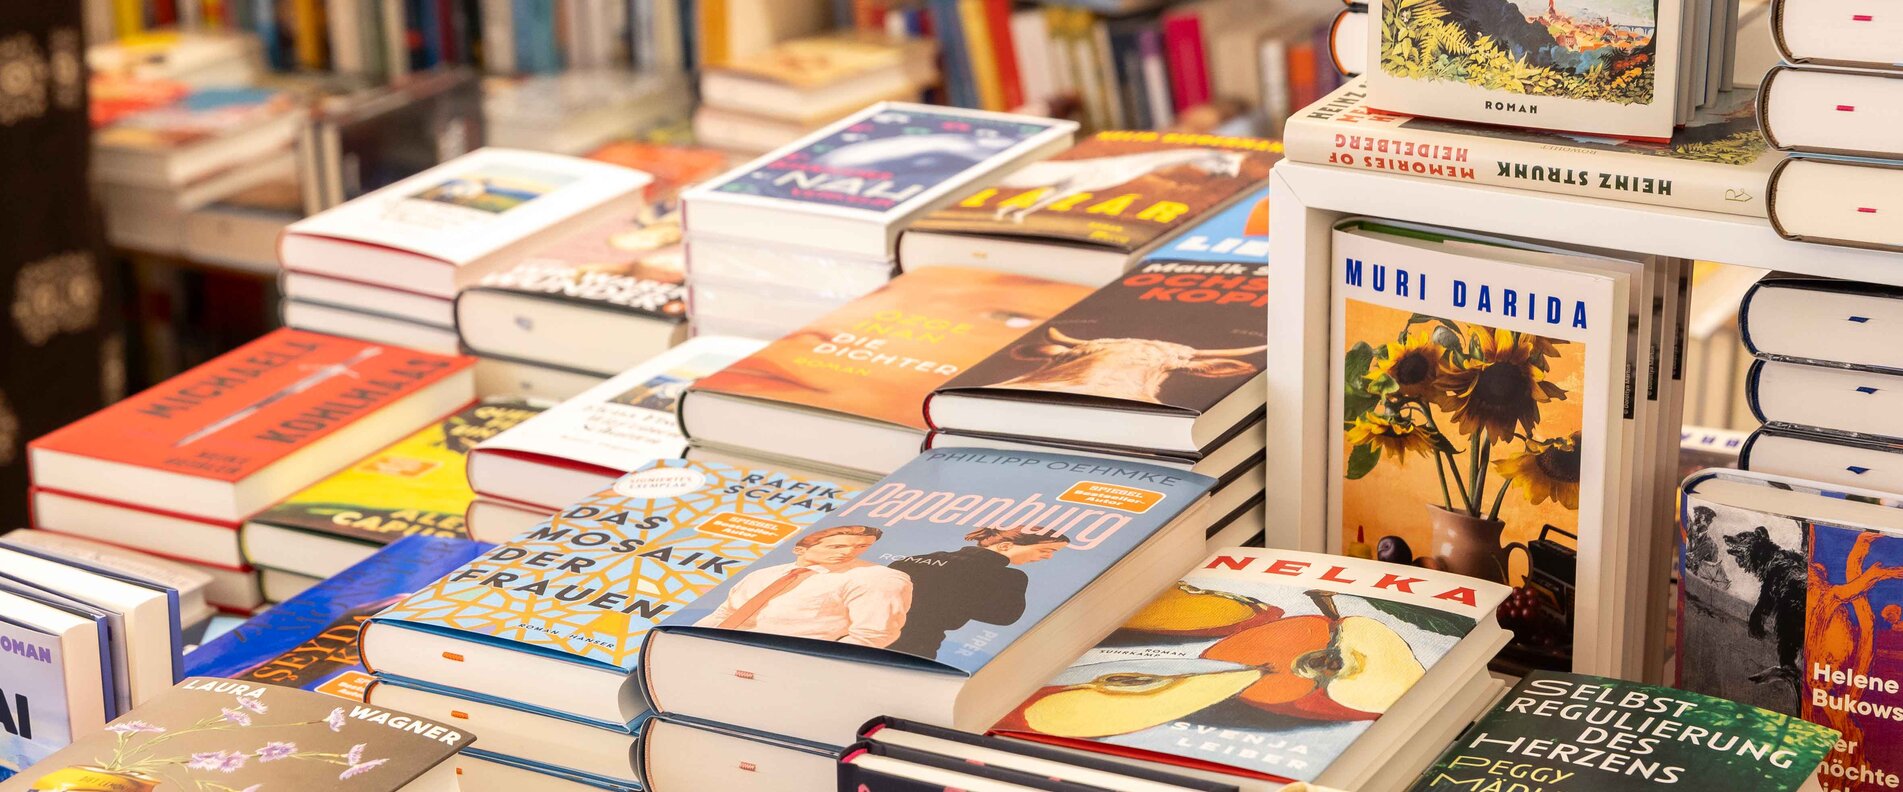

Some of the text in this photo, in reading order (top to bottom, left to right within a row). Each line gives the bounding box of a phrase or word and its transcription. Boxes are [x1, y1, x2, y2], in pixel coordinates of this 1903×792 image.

[1306, 91, 1367, 120] HEINZ
[1485, 100, 1538, 115] ROMAN
[1335, 133, 1468, 163] HEIDELBERG
[1328, 151, 1476, 180] MEMORIES OF
[1497, 160, 1673, 197] HEINZ STRUNK
[1142, 262, 1248, 275] Manik
[1345, 258, 1588, 330] MURI DARIDA
[831, 331, 888, 351] DIE
[792, 355, 872, 378] ROMAN
[811, 342, 959, 377] DICHTER
[254, 357, 452, 445] KOHLHAAS
[926, 452, 1182, 488] PHILIPP OEHMKE
[741, 473, 845, 499] RAFIK
[1074, 489, 1146, 507] Bestseller-
[1089, 483, 1143, 499] SPIEGEL
[838, 482, 1133, 551] Papenburg
[1084, 496, 1124, 508] Autor
[562, 505, 668, 531] DAS
[712, 520, 779, 537] Bestseller-
[721, 527, 759, 538] Autor
[728, 516, 779, 531] SPIEGEL
[488, 546, 596, 575] DER
[525, 525, 742, 575] MOSAIK
[878, 552, 949, 568] ROMAN
[450, 567, 670, 620] FRAUEN
[1202, 554, 1479, 608] NELKA
[517, 622, 615, 649] ROMAN HANSER
[961, 628, 999, 658] PIPER
[1100, 649, 1162, 658] SUHRKAMP
[1145, 648, 1187, 657] ROMAN
[181, 679, 268, 699] LAURA
[1812, 661, 1900, 695] Helene
[1521, 679, 1699, 719] SELBST
[1812, 687, 1903, 722] Bukows
[348, 705, 462, 747] WAGNER
[1170, 721, 1309, 755] SVENJA
[1505, 696, 1802, 770] REGULIERUNG
[1576, 725, 1661, 756] DES
[1176, 737, 1309, 771] LEIBER
[1468, 731, 1687, 785] HERZENS
[1833, 739, 1858, 755] er
[1447, 755, 1576, 785] PEGGY
